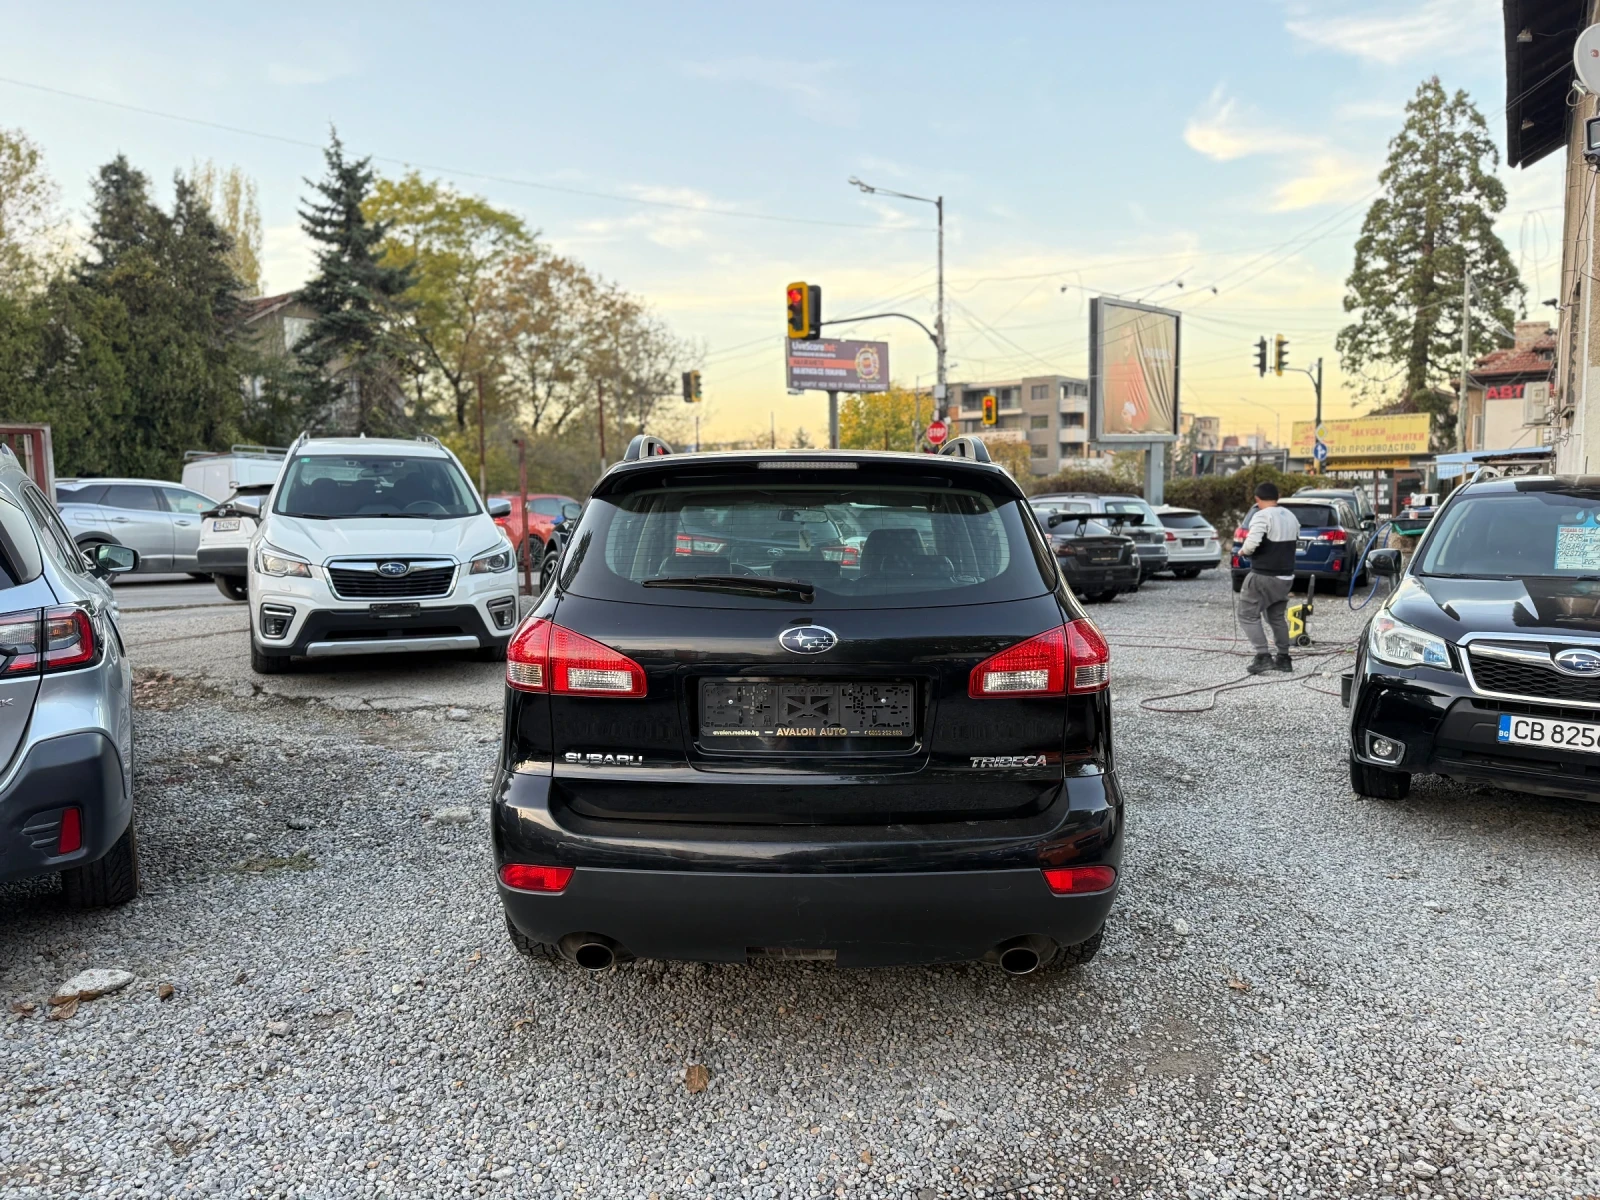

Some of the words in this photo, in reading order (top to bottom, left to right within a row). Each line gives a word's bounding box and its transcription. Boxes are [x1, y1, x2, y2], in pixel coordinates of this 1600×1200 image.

[929, 427, 945, 437] STOP
[1351, 427, 1386, 437] ЗАКУСКИ
[1385, 432, 1425, 442] НАПИТКИ
[1349, 442, 1416, 453] ПРОИЗВОДСТВО
[1338, 471, 1374, 479] ПОРЪЧКИ
[776, 728, 816, 736] AVALON
[820, 728, 848, 736] AUTO
[1514, 720, 1545, 741] CB
[565, 752, 643, 765] SUBARU
[970, 754, 1047, 768] TRIBECA
